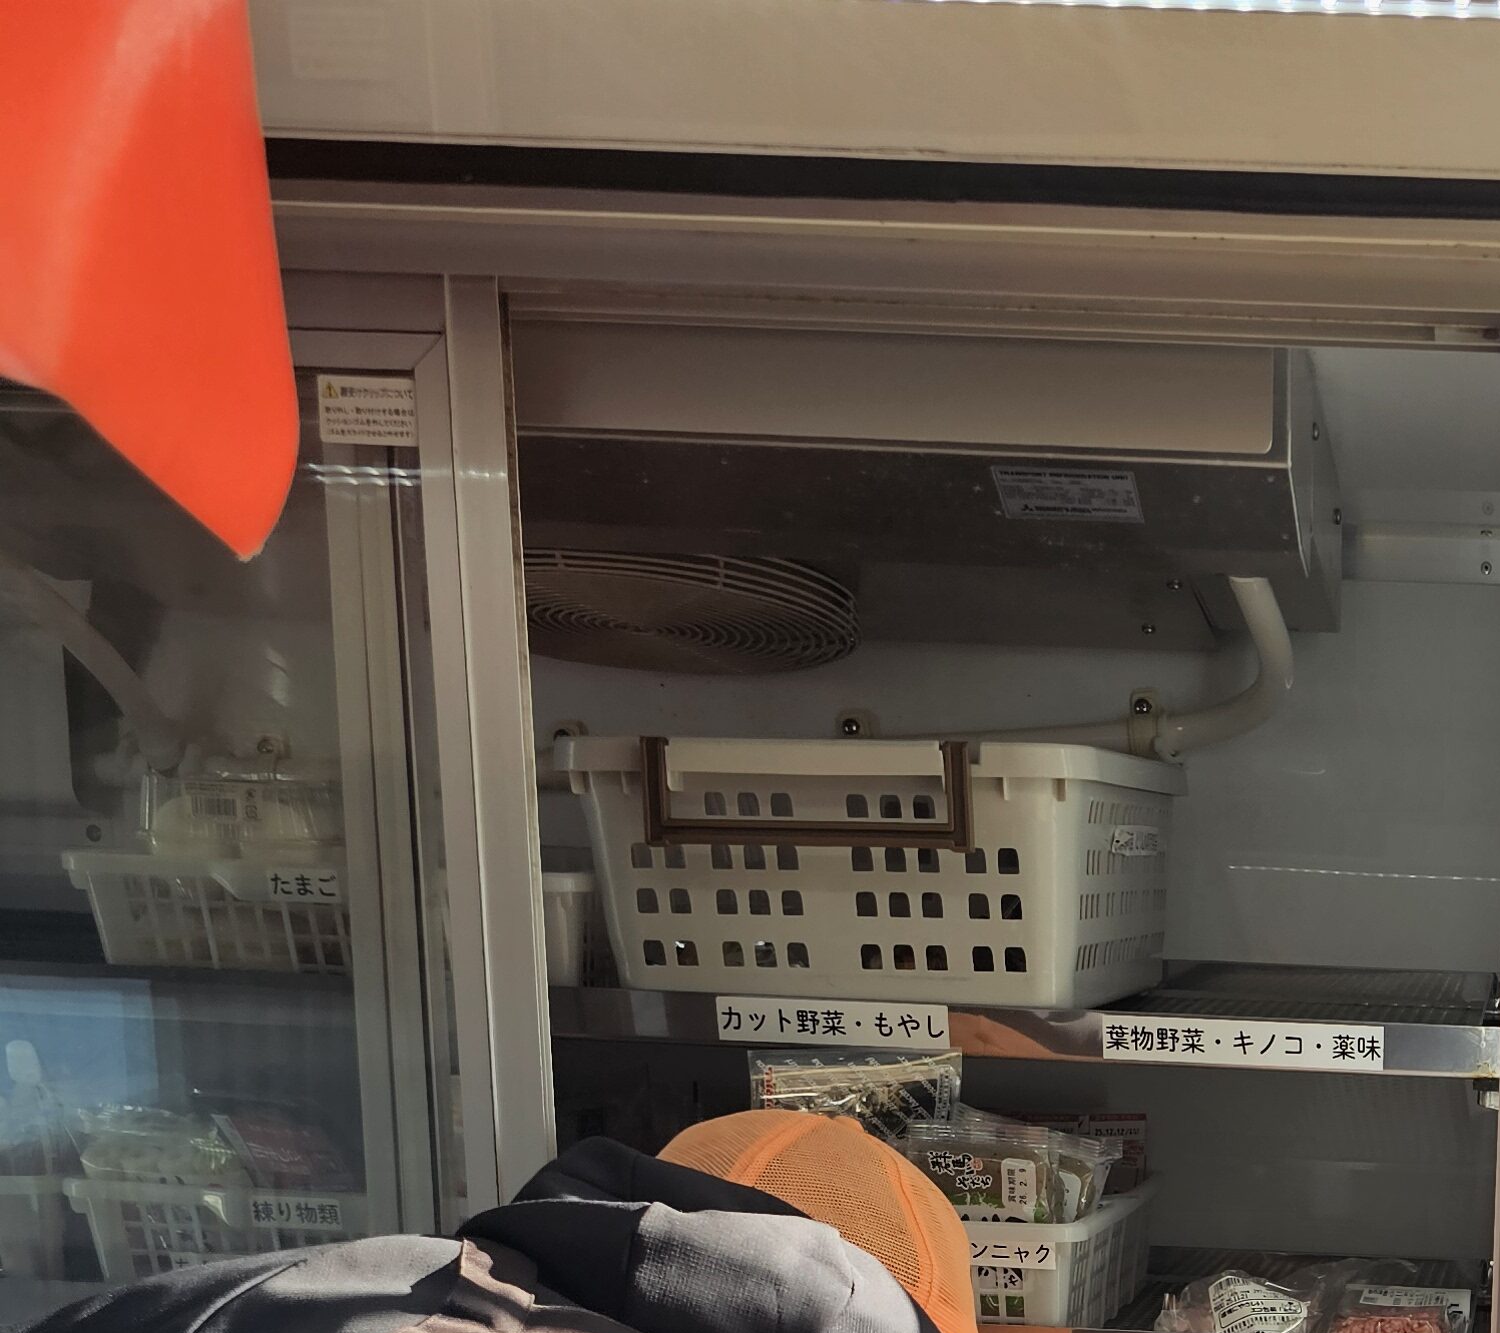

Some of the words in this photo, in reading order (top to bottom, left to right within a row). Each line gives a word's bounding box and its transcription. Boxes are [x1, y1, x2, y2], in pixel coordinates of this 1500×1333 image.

[270, 872, 336, 897] たまご
[721, 1006, 945, 1038] カット野菜・もやし
[1105, 1024, 1383, 1062] 葉物野菜・キノコ・薬味
[252, 1201, 340, 1225] 練り物類
[970, 1243, 1051, 1263] ンニャク
